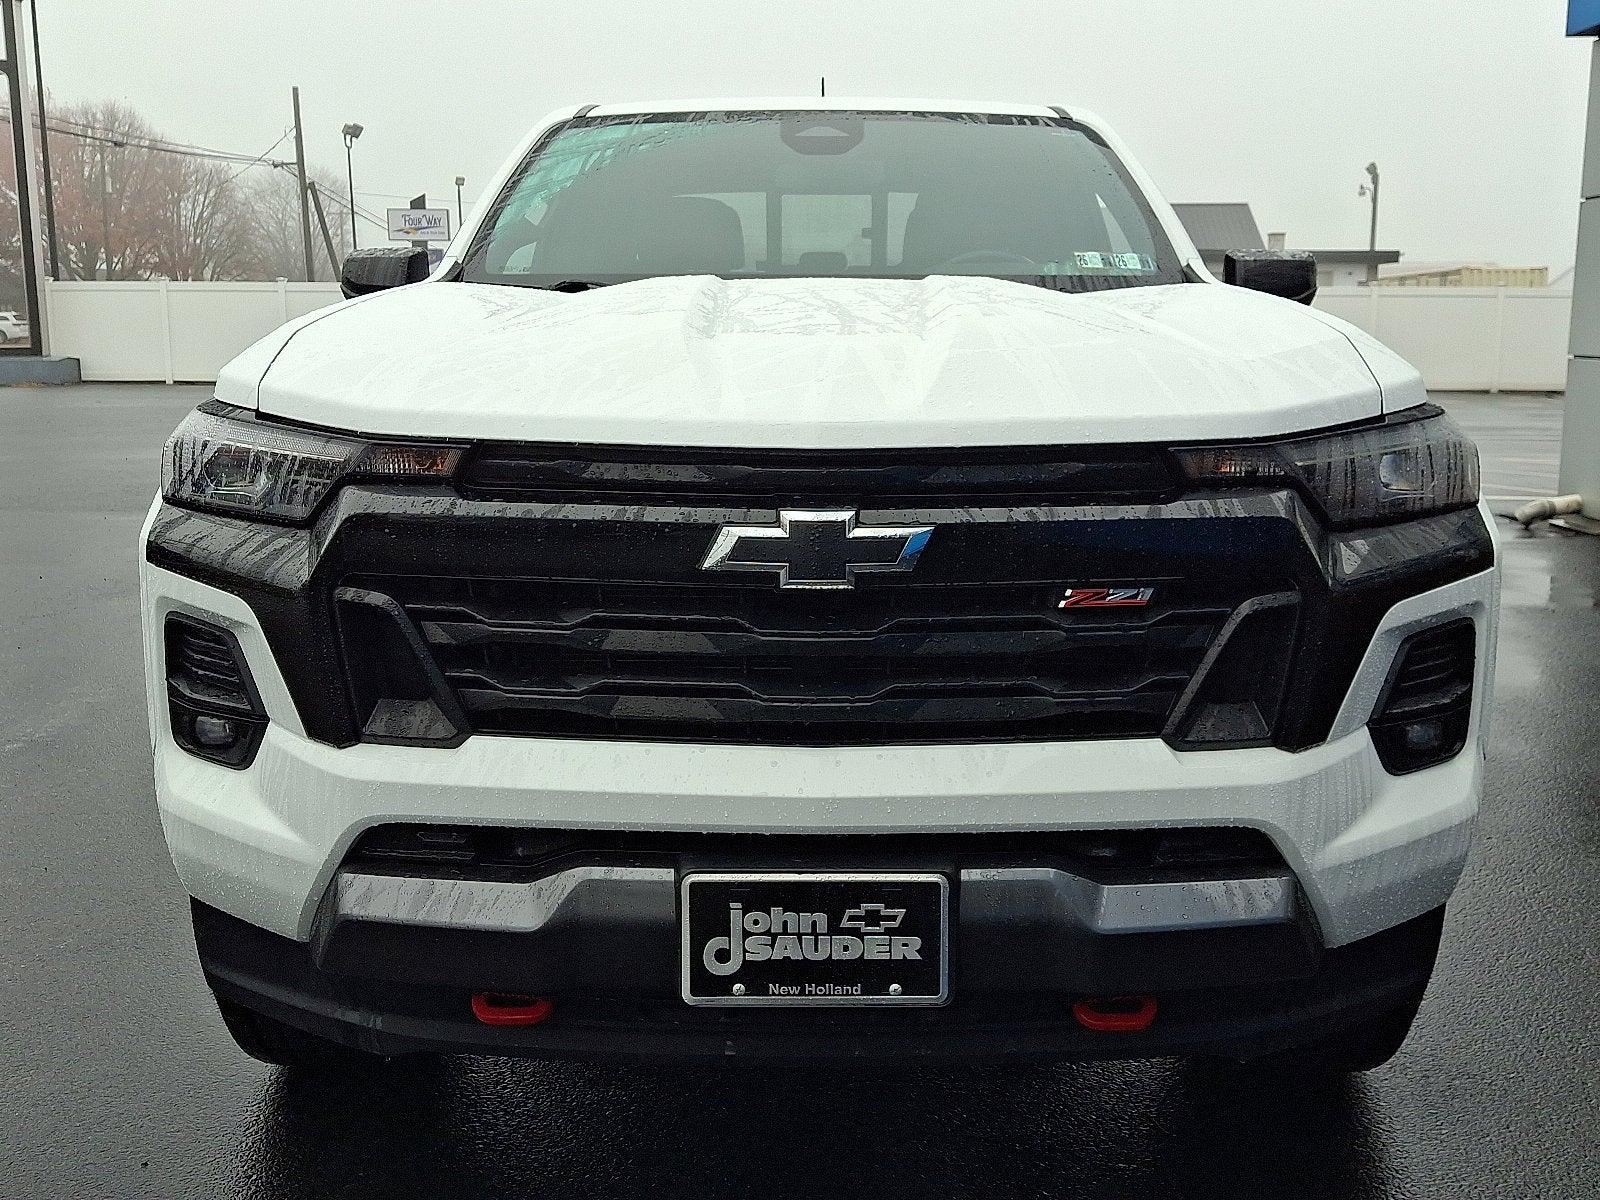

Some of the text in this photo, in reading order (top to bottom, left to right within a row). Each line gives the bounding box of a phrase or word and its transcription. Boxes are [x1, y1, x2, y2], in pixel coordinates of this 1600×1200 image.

[1077, 254, 1089, 266] 26
[1115, 255, 1128, 267] 26
[1058, 588, 1154, 608] Z71
[703, 903, 828, 976] john
[745, 936, 922, 961] SAUDER
[769, 983, 862, 995] New Holland
